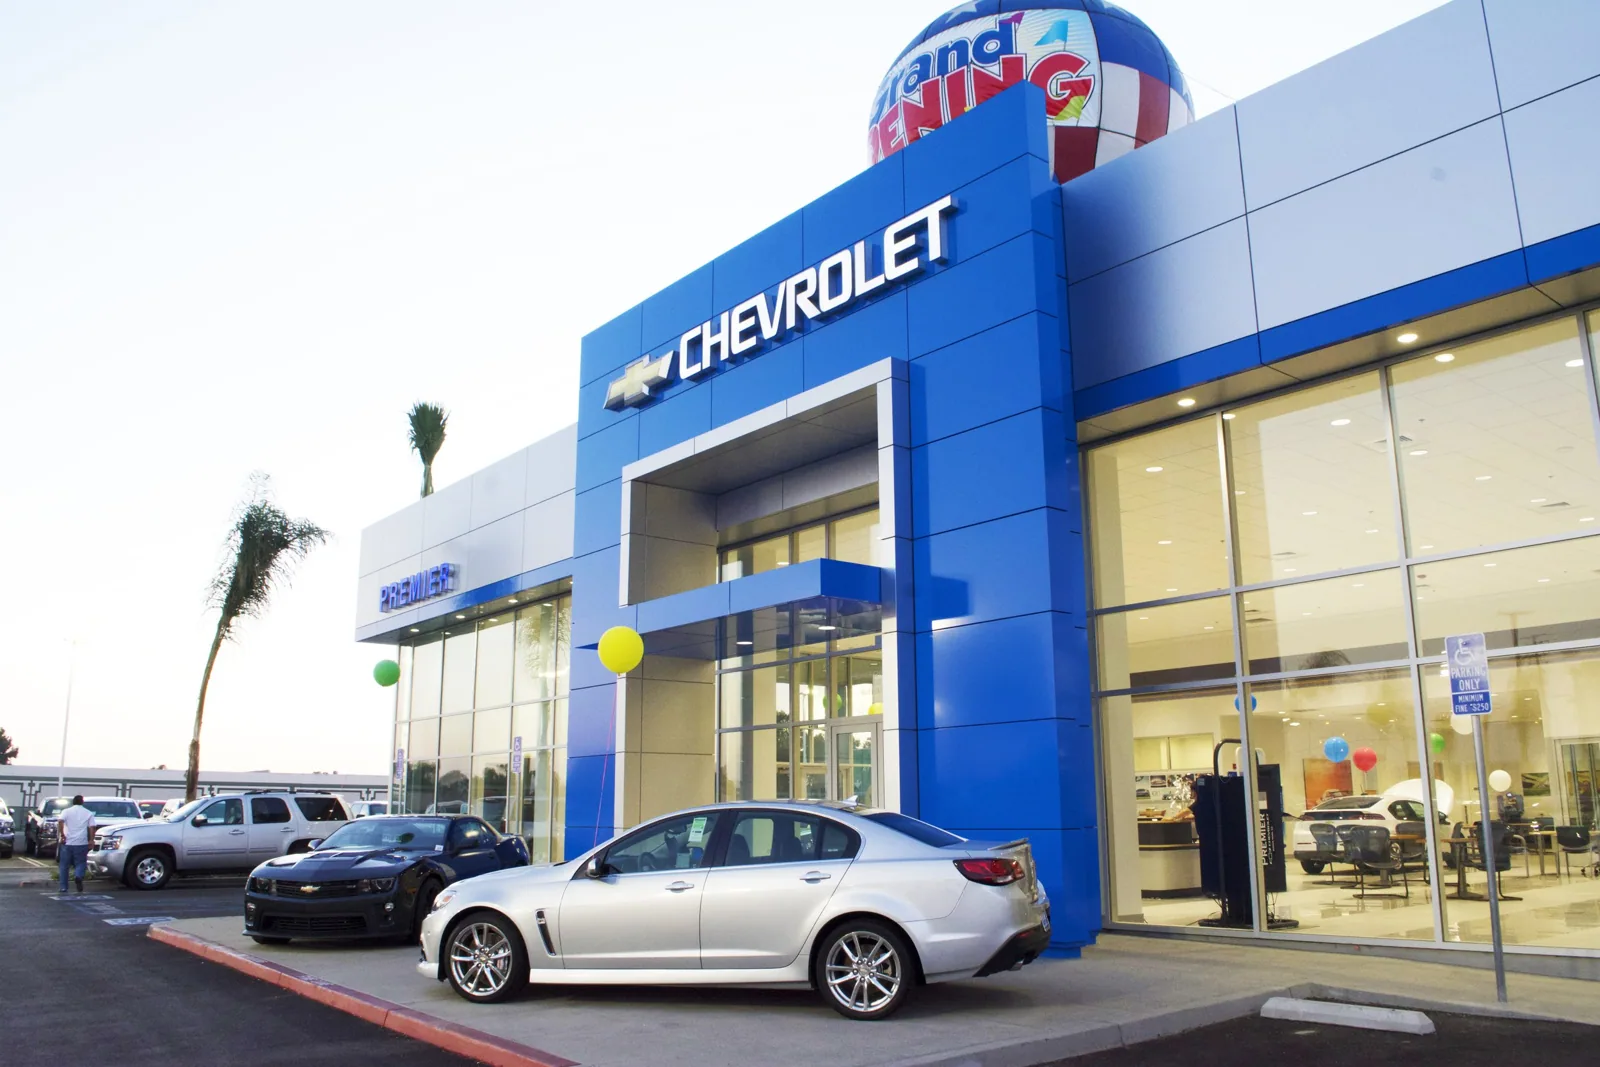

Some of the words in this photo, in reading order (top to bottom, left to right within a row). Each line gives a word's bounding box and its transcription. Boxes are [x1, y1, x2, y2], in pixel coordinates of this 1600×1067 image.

[678, 194, 952, 380] CHEVROLET
[379, 563, 450, 613] PREMIER
[1451, 667, 1486, 679] PARKING
[1459, 679, 1480, 690] ONLY
[1458, 694, 1483, 703] MINIMUM
[1455, 704, 1468, 713] FINE
[1260, 814, 1268, 866] PREMIER
